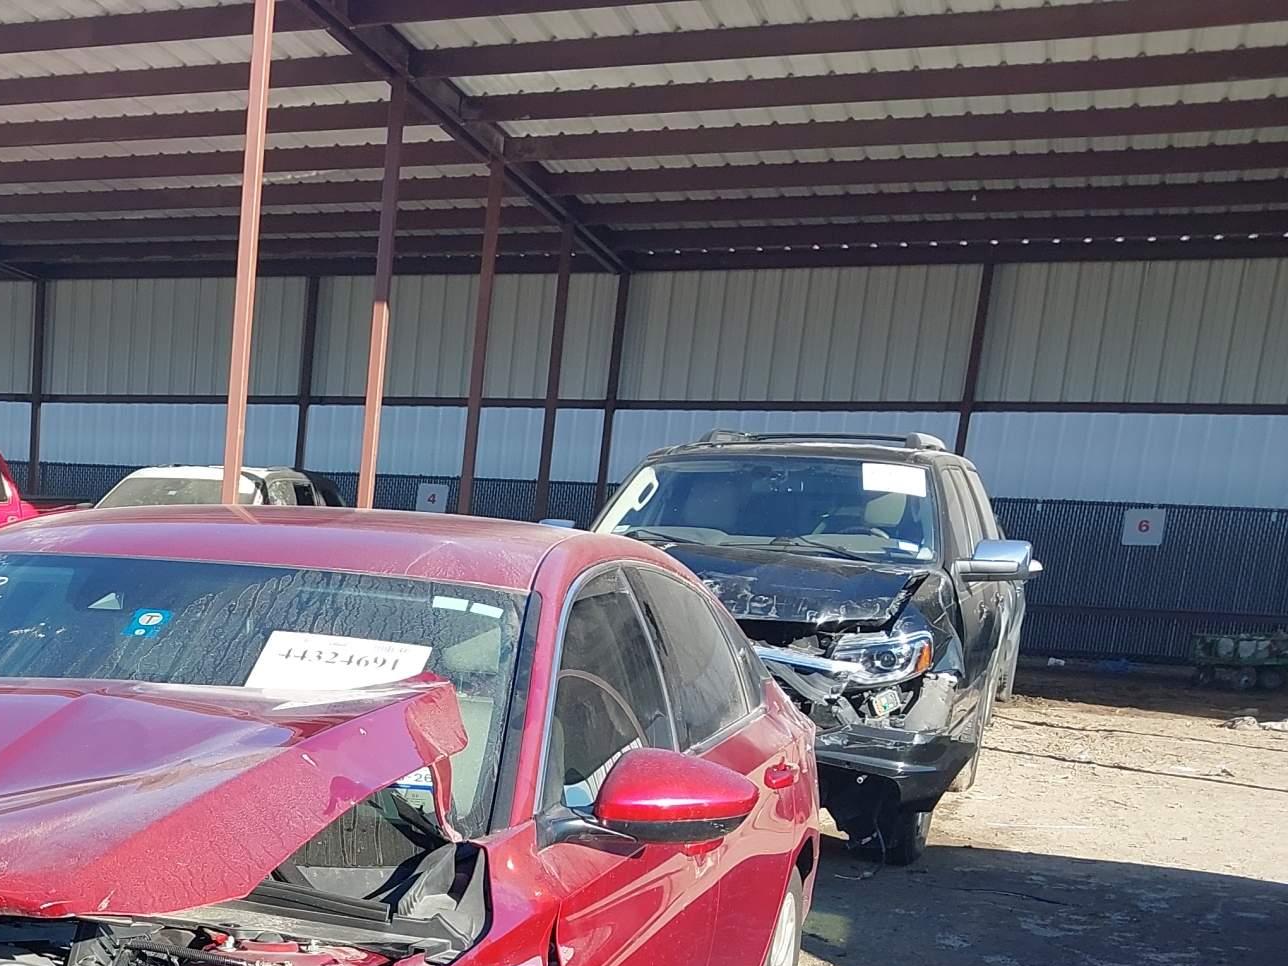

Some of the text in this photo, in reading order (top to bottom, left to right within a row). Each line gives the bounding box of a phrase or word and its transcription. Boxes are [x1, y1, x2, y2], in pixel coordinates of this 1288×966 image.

[427, 493, 436, 504] 4
[1138, 519, 1150, 533] 6
[278, 647, 400, 671] 44324691
